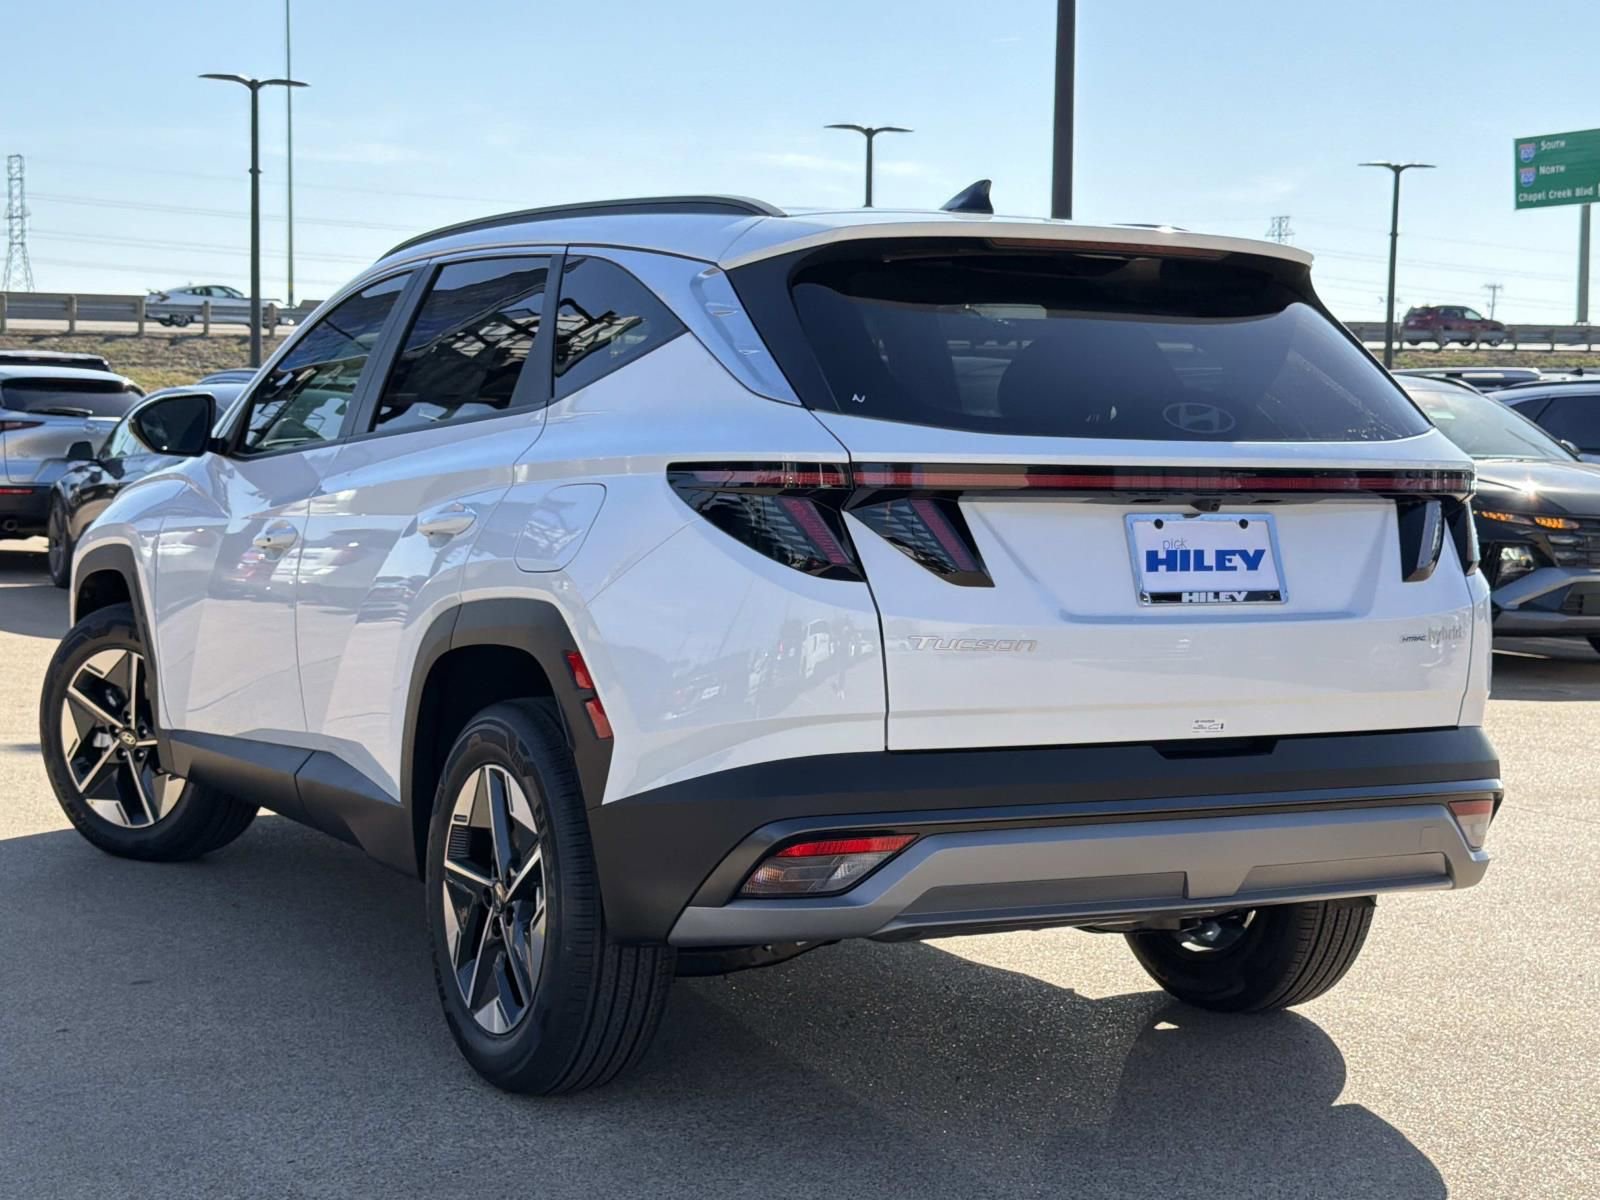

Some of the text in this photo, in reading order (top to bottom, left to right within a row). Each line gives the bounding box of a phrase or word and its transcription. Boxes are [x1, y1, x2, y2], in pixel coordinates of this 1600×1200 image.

[1539, 165, 1565, 175] NORTH
[1519, 191, 1546, 202] Chapel
[1548, 189, 1572, 199] Creek
[1575, 187, 1593, 197] Blvd
[1146, 549, 1266, 572] HILEY
[1181, 591, 1248, 603] HILEY
